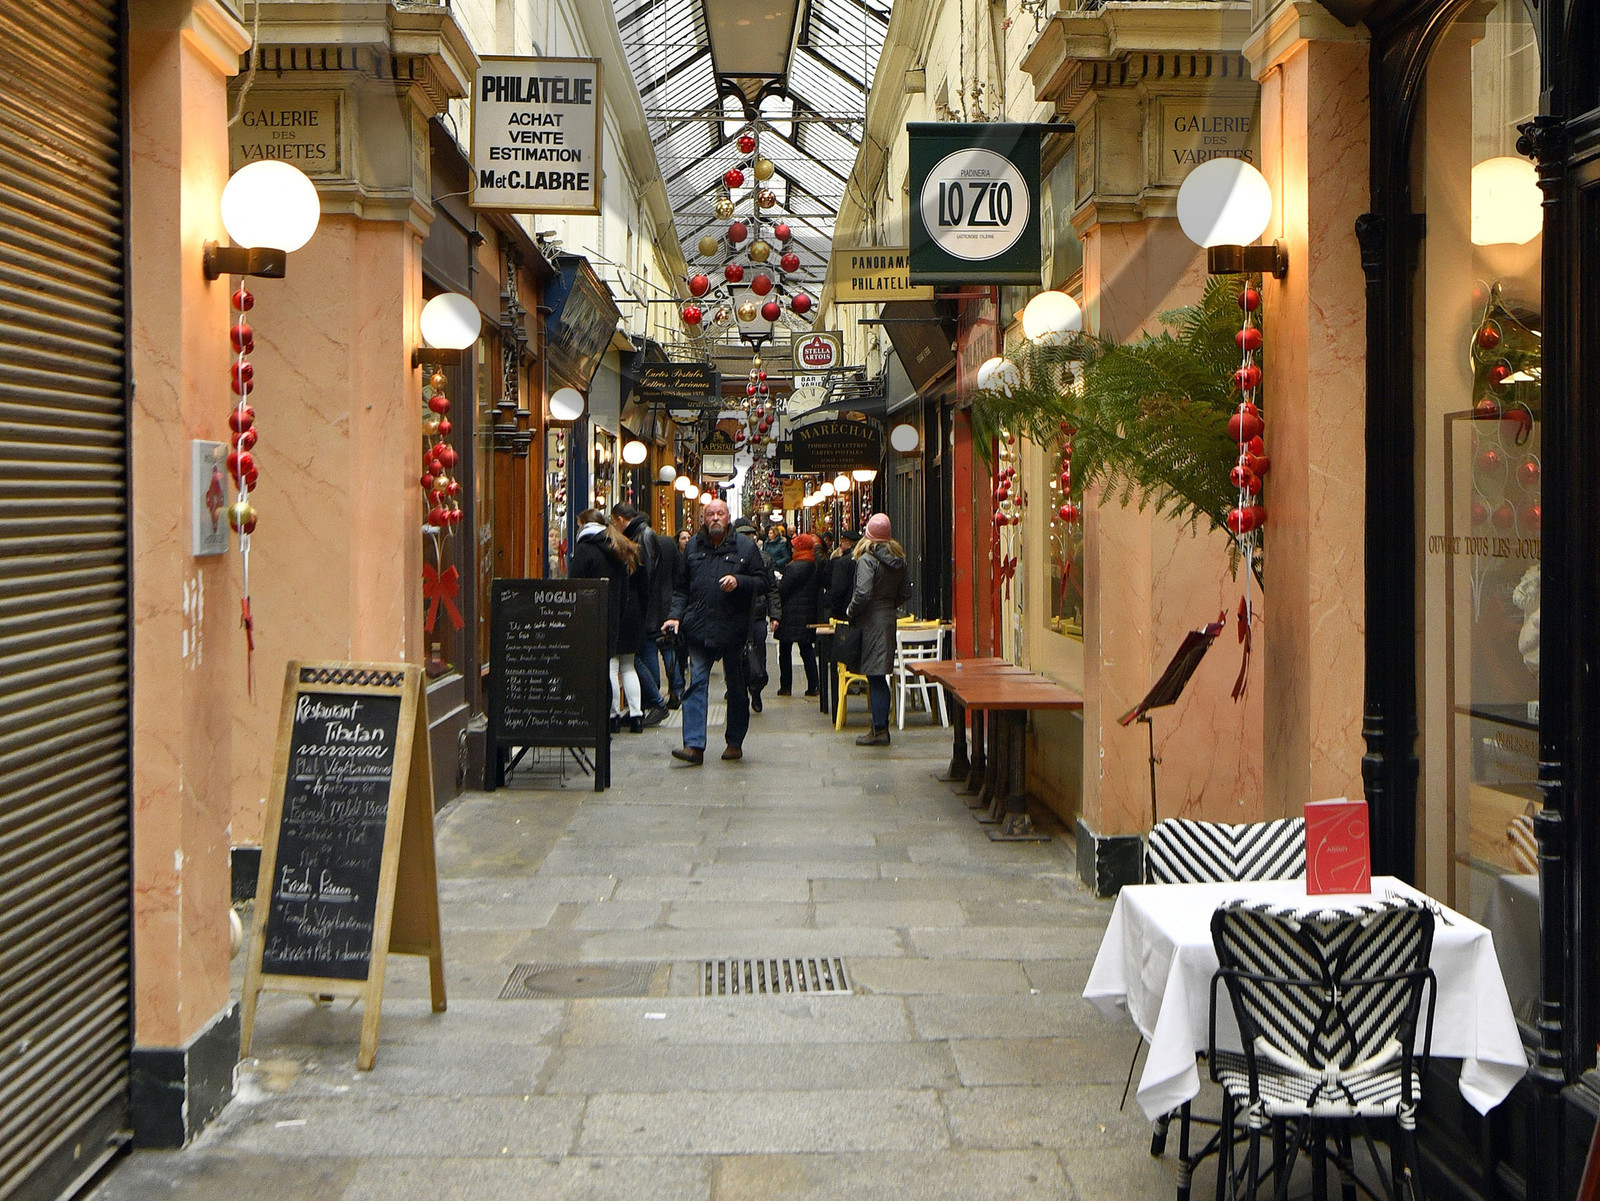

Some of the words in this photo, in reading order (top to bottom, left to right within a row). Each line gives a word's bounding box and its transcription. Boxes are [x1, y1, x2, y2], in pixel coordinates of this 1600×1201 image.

[243, 110, 318, 127] GALERIE
[508, 113, 563, 126] ACHAT
[1174, 115, 1250, 132] GALERIE
[272, 131, 296, 139] DES
[509, 131, 563, 144] VENTE
[490, 147, 581, 162] ESTIMATION
[960, 169, 990, 177] PIADINERIA
[938, 181, 963, 226] LO
[852, 277, 916, 290] PHILATELI
[645, 368, 668, 378] Cartes
[671, 368, 703, 378] Postales
[640, 379, 666, 388] Lettres
[668, 379, 709, 388] Anciennes
[800, 422, 876, 441] MARÉCHAL
[1465, 536, 1489, 557] TOUS
[1493, 537, 1510, 558] LES
[1515, 538, 1541, 560] JOU
[296, 695, 363, 723] Restaurant
[325, 721, 385, 744] Tibetan
